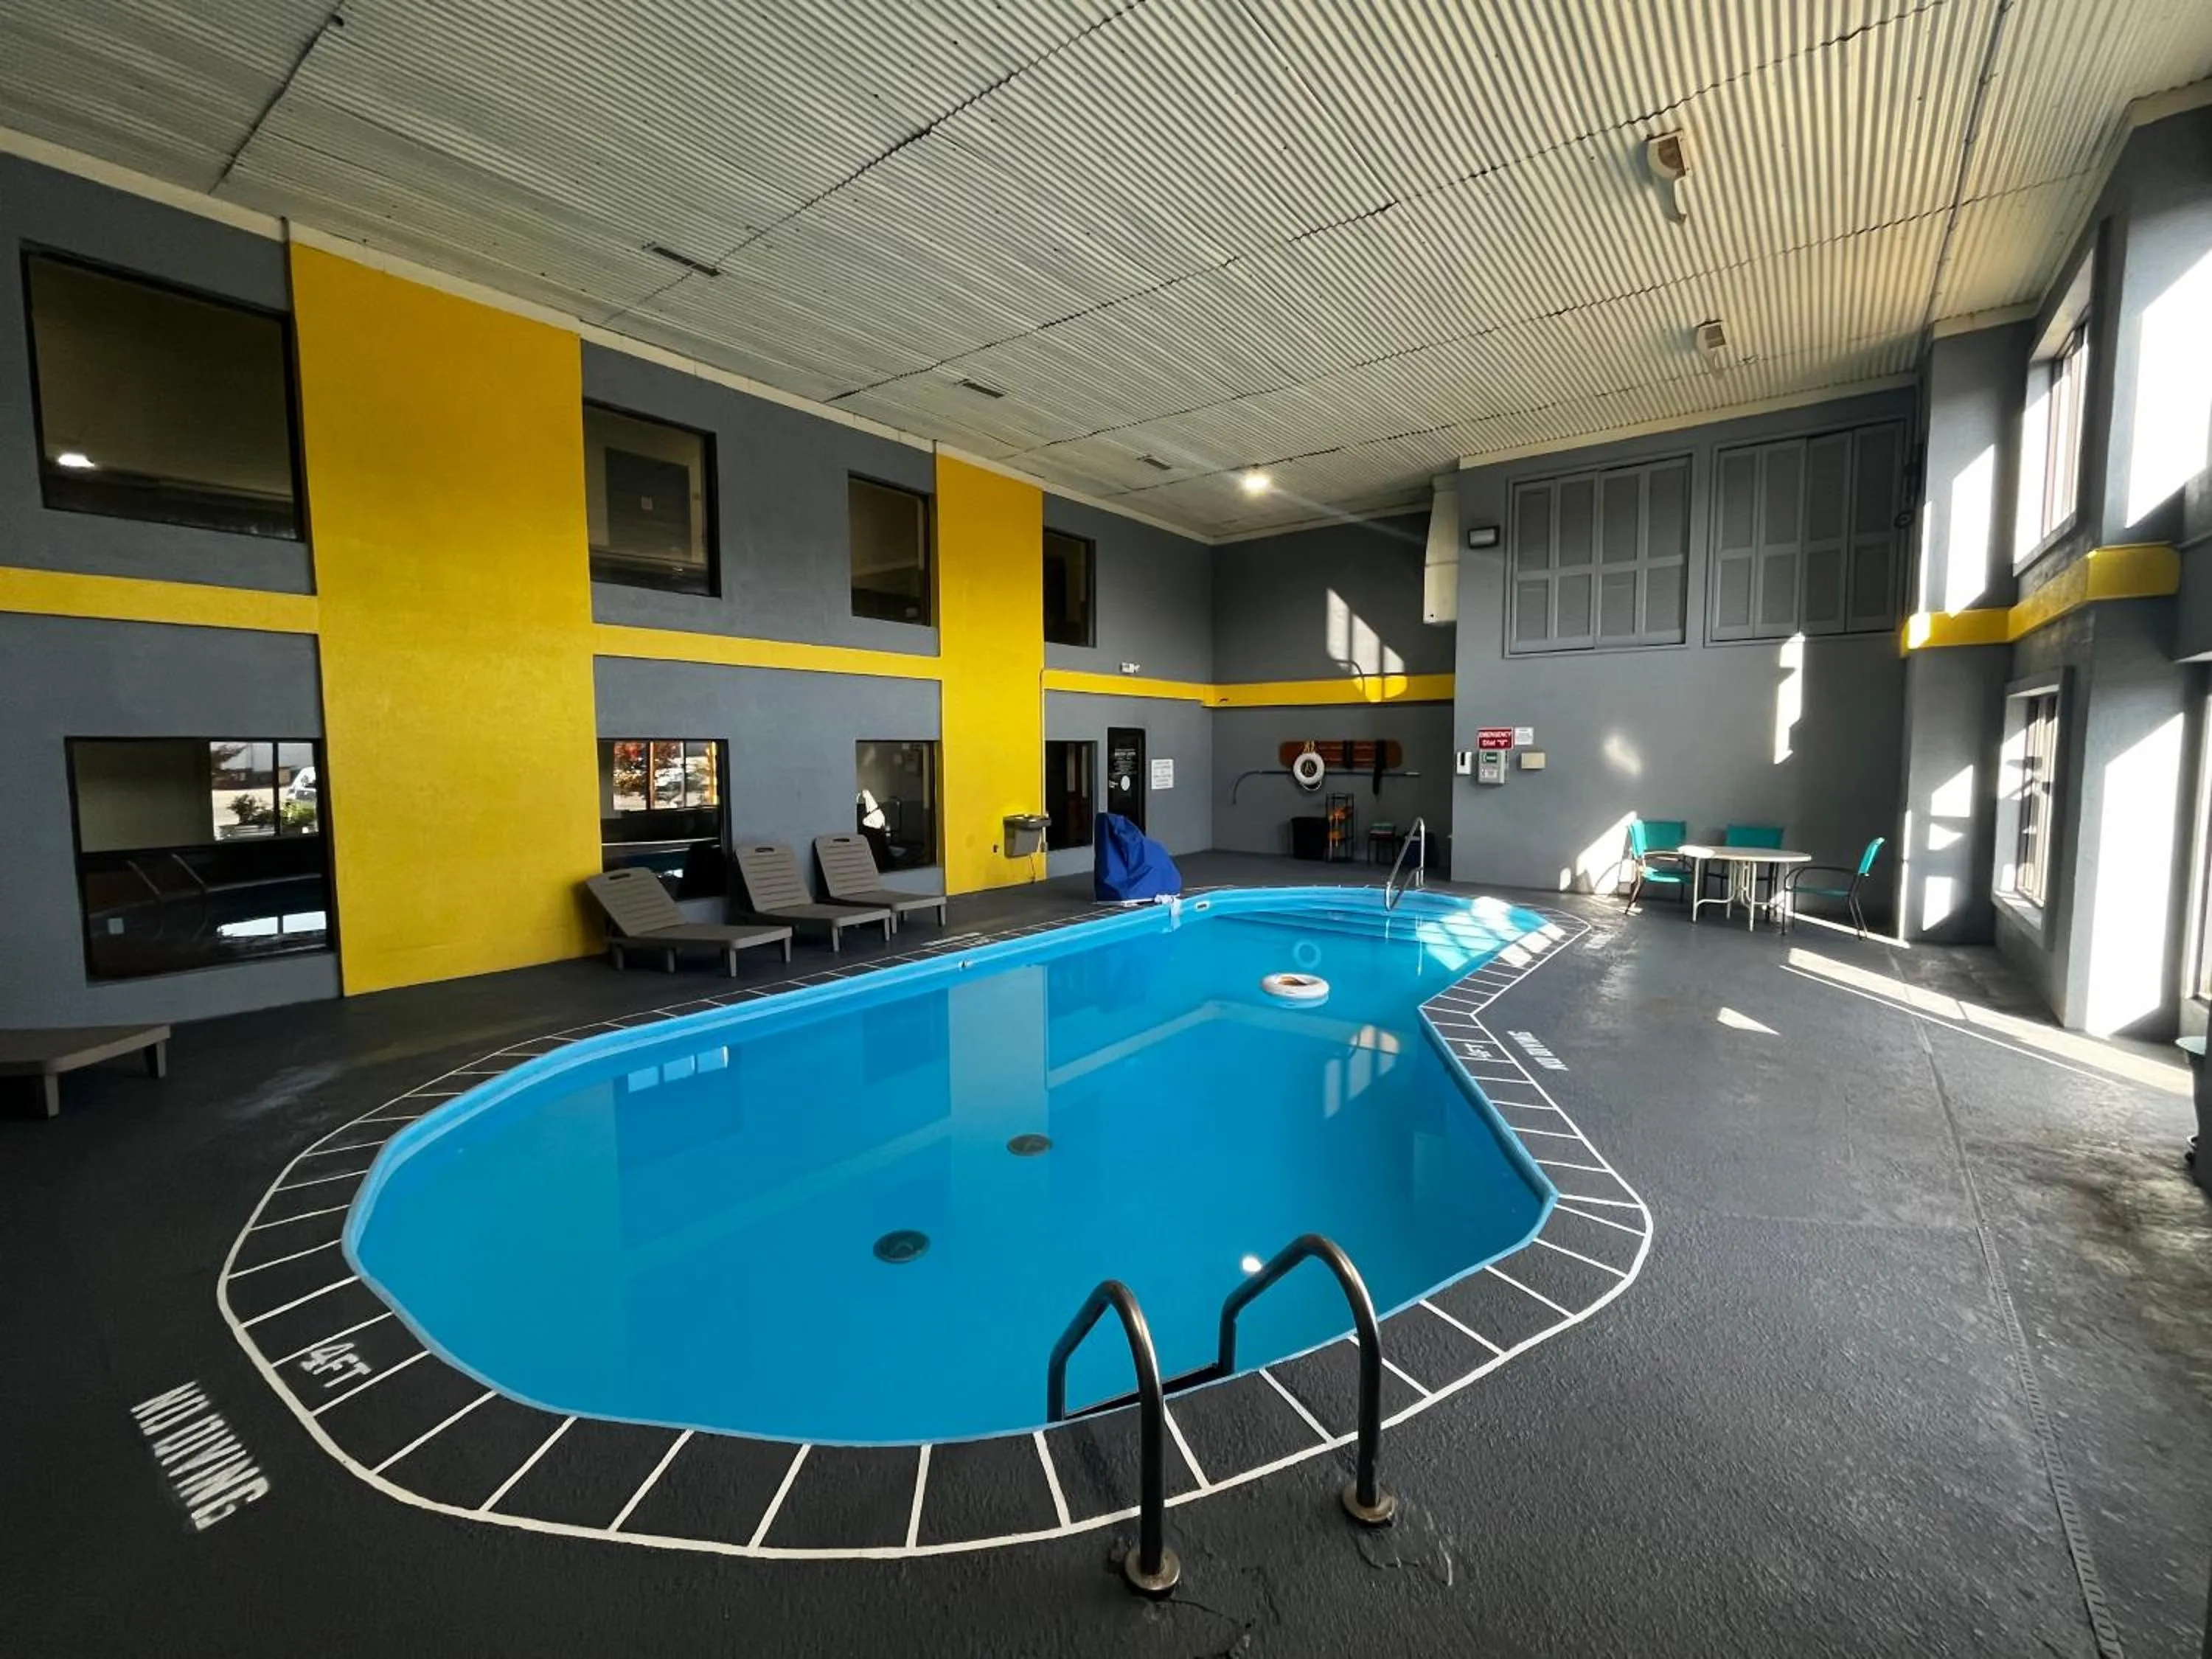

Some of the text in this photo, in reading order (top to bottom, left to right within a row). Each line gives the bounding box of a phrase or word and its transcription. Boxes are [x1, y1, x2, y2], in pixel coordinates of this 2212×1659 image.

[299, 1342, 372, 1388] 4FT
[129, 1379, 271, 1531] NO DIVING
